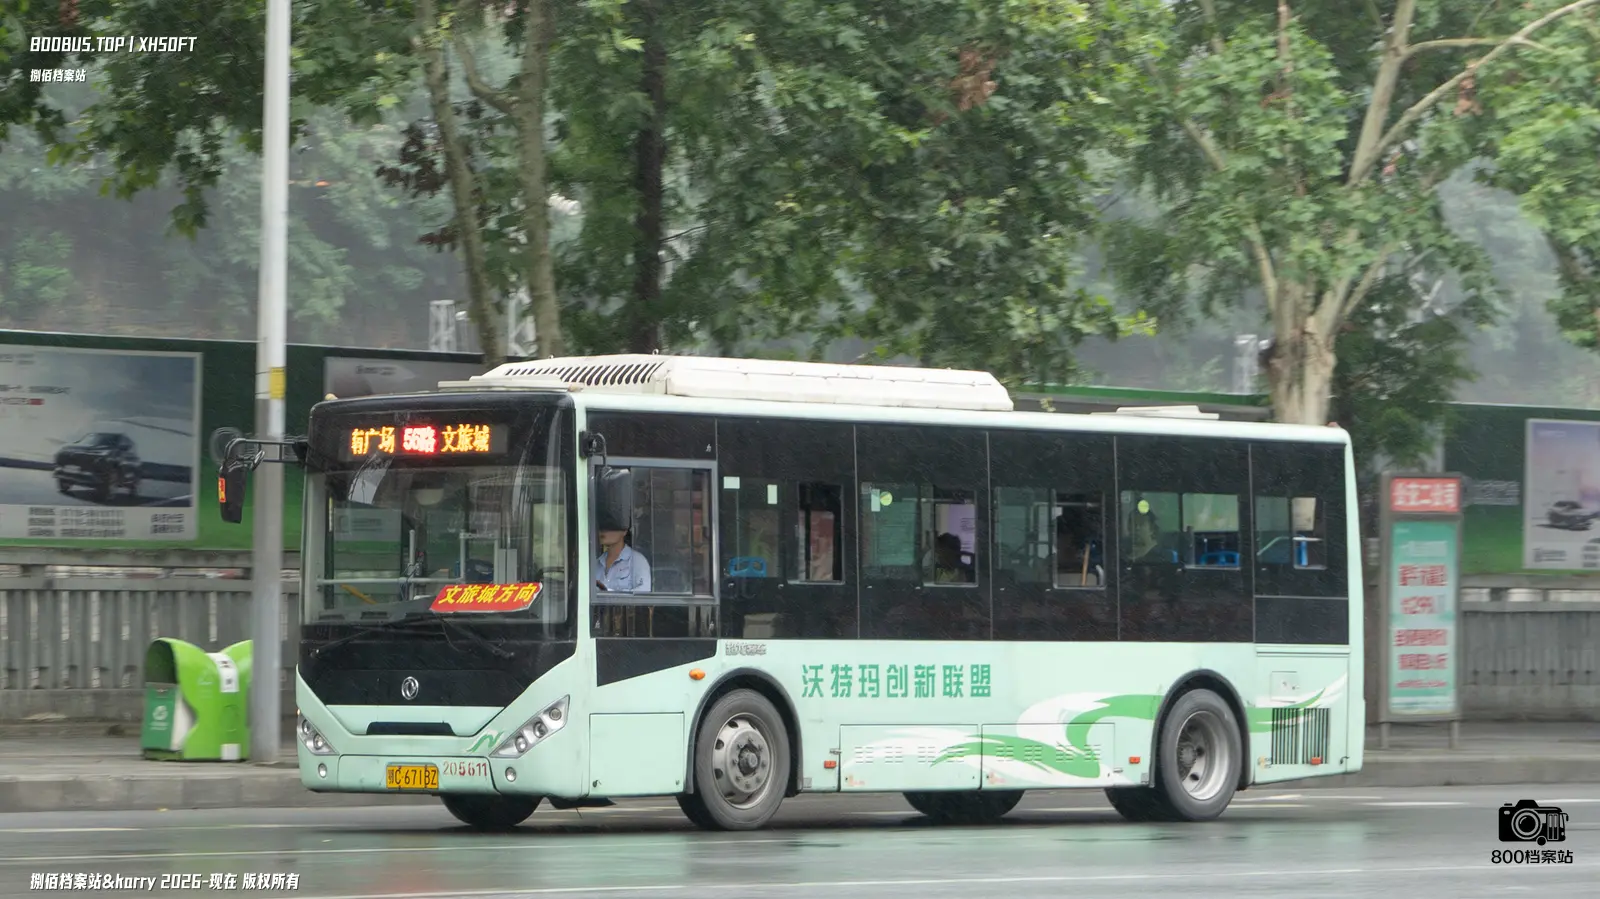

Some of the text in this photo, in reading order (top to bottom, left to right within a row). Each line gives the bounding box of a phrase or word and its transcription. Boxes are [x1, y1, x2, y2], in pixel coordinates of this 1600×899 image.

[440, 423, 490, 453] 文旅城
[438, 582, 538, 605] 文旅城方向
[801, 663, 992, 698] 沃特玛创新联盟
[442, 761, 488, 777] 205611
